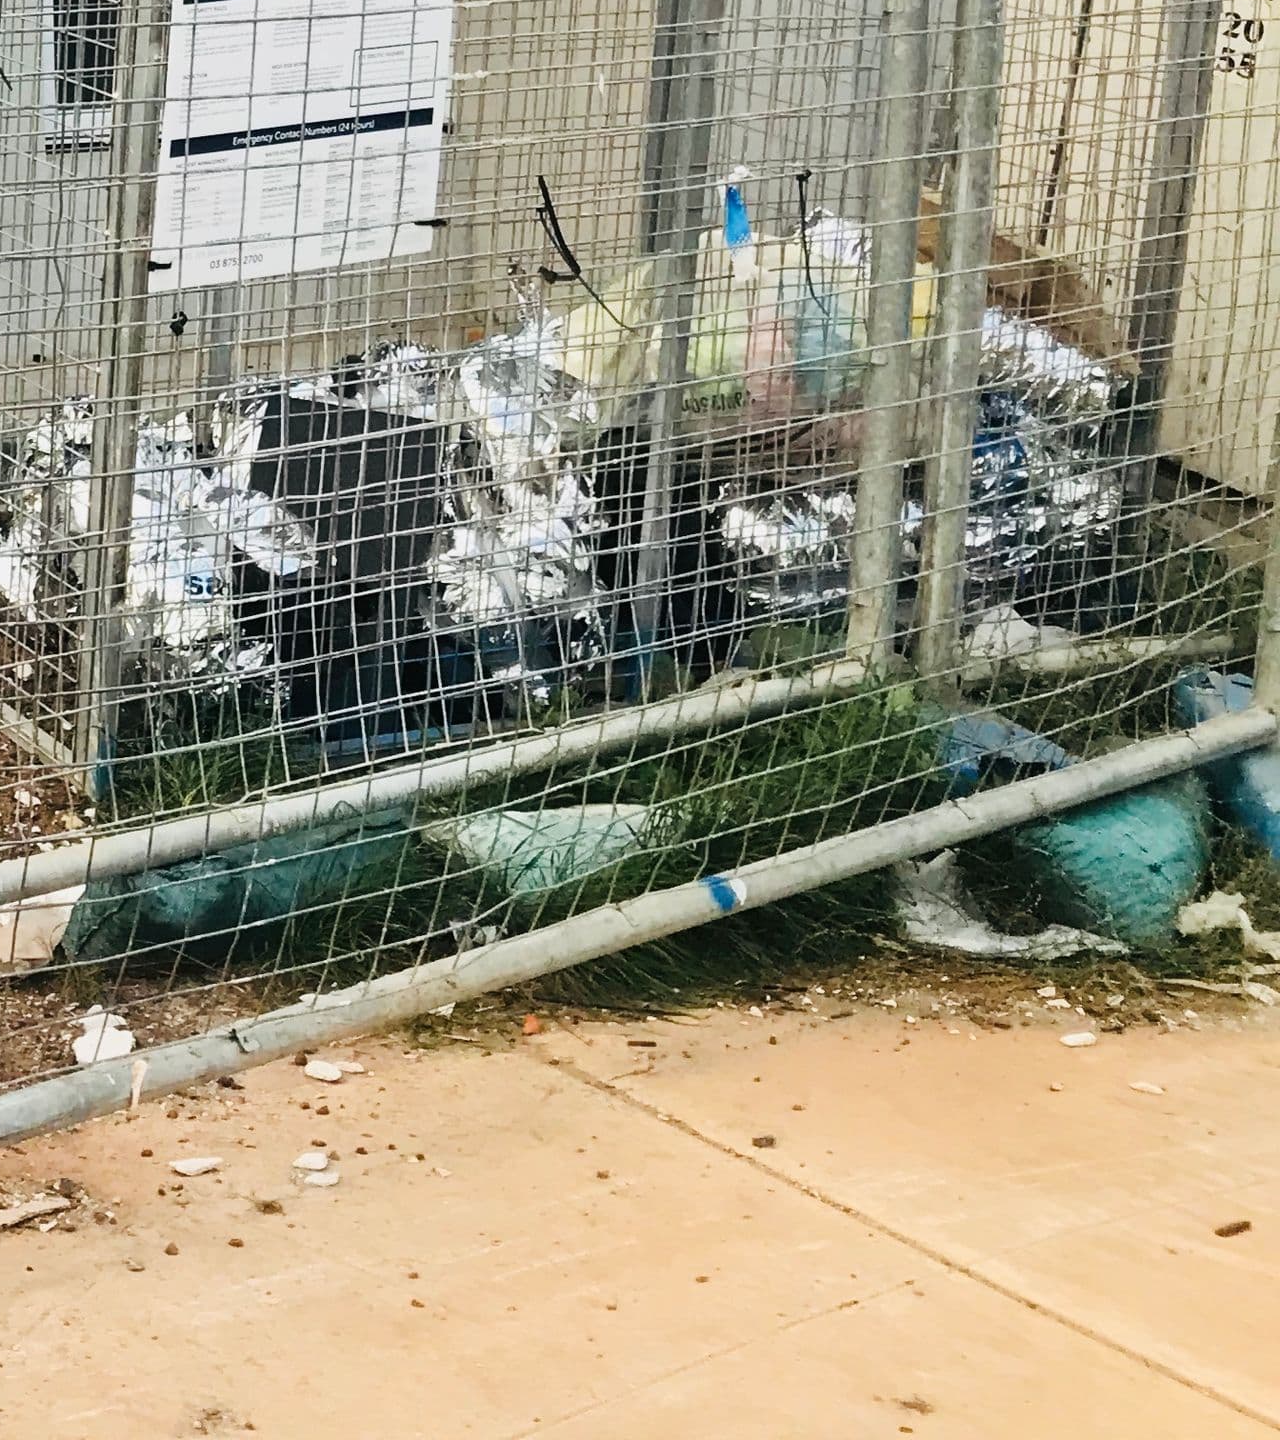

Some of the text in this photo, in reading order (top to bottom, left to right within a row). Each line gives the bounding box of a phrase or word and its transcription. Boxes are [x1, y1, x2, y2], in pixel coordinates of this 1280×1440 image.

[232, 132, 274, 147] Emergency
[274, 130, 303, 141] Contac
[305, 125, 338, 137] Numbers
